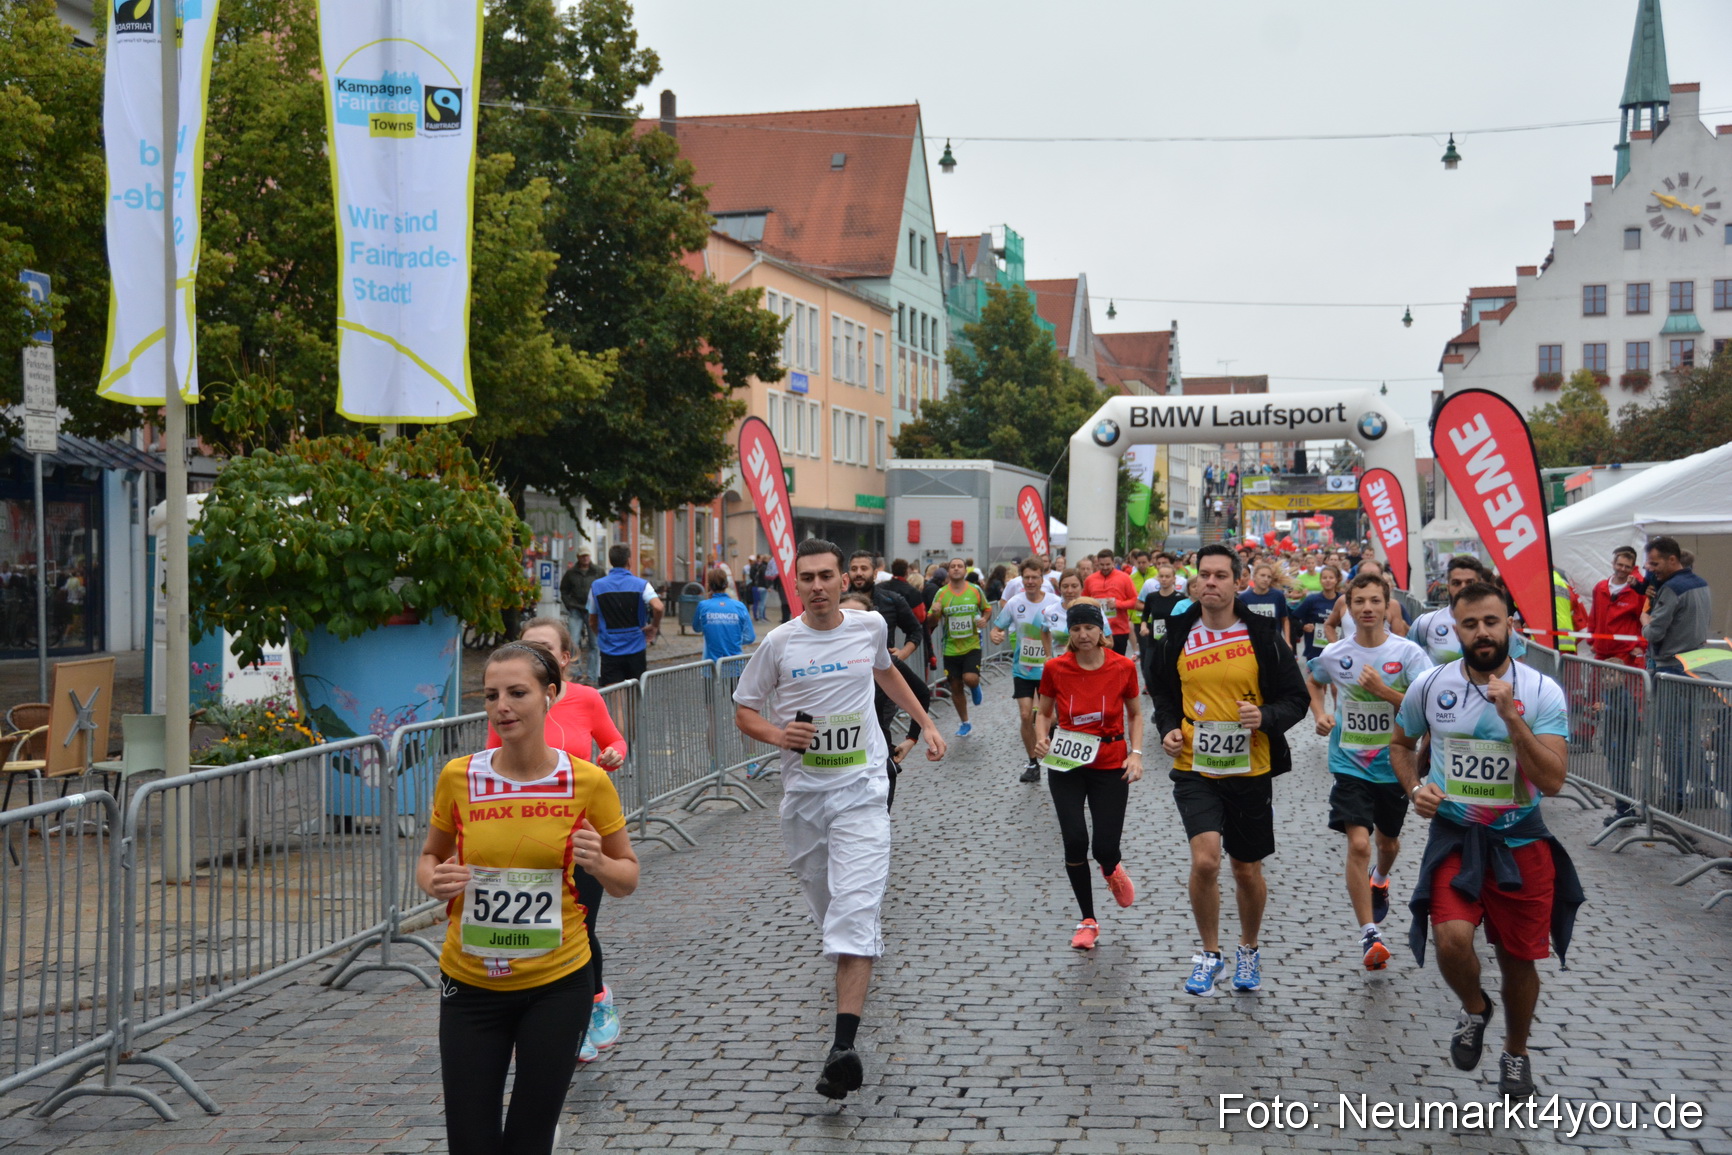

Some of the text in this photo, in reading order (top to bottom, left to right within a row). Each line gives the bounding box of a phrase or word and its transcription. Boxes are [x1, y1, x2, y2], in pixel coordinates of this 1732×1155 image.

[337, 79, 412, 96] Kampagne
[338, 93, 420, 112] Fairtrade
[371, 118, 414, 131] Towns
[425, 121, 460, 130] FAIRTRADE
[347, 204, 438, 234] Wir sind
[350, 241, 458, 269] Fairtrade-
[352, 277, 412, 304] Stadt!
[1130, 402, 1347, 429] BMW Laufsport
[1448, 412, 1538, 561] REWE
[747, 437, 794, 577] REWE
[1287, 497, 1313, 507] ZIEL
[1366, 478, 1403, 548] REWE
[1021, 495, 1047, 556] REWE
[706, 612, 739, 620] ERDINGER
[951, 620, 970, 630] 5264
[1156, 625, 1167, 633] 52
[792, 658, 848, 678] RÖDL
[1186, 644, 1256, 672] MAX BÖ
[1347, 712, 1390, 732] 5306
[1053, 738, 1092, 762] 5088
[1199, 733, 1246, 754] 5242
[815, 756, 854, 766] Christian
[1206, 757, 1236, 767] Gerhard
[1451, 754, 1510, 781] 5262
[1462, 785, 1495, 796] Khaled
[469, 802, 574, 822] MAX BÖGL
[507, 871, 553, 883] BOCK
[473, 889, 553, 925] 5222
[489, 932, 530, 946] Judith
